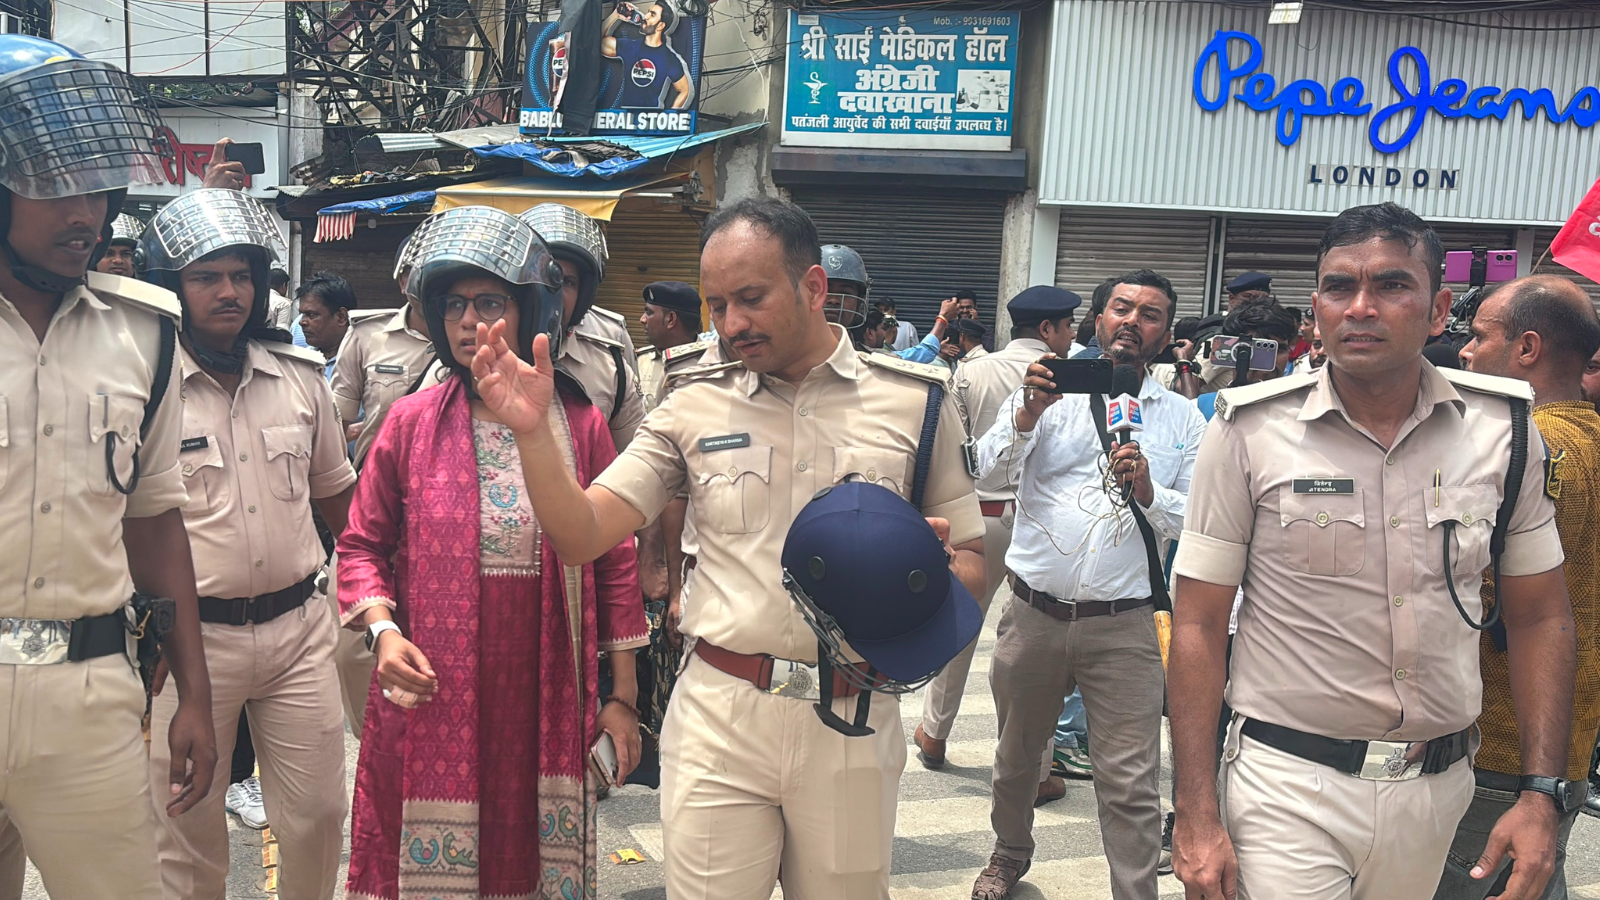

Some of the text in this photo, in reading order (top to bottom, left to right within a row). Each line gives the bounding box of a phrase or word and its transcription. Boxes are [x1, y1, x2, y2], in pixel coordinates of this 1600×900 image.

[933, 16, 952, 25] Mob.
[801, 26, 827, 60] श्री
[879, 26, 958, 61] मेडिकल
[964, 27, 1009, 61] हॉल
[633, 68, 654, 78] PEPSI
[855, 64, 940, 92] अंग्रेजी
[837, 91, 955, 113] दवाखाना
[1193, 30, 1600, 153] Pepe Jeans
[596, 111, 635, 130] ERAL
[638, 112, 690, 130] STORE
[791, 113, 830, 128] पतंजली
[833, 114, 869, 132] आयुर्वेद
[872, 115, 887, 129] की
[890, 116, 911, 130] सभी
[1310, 164, 1457, 189] LONDON
